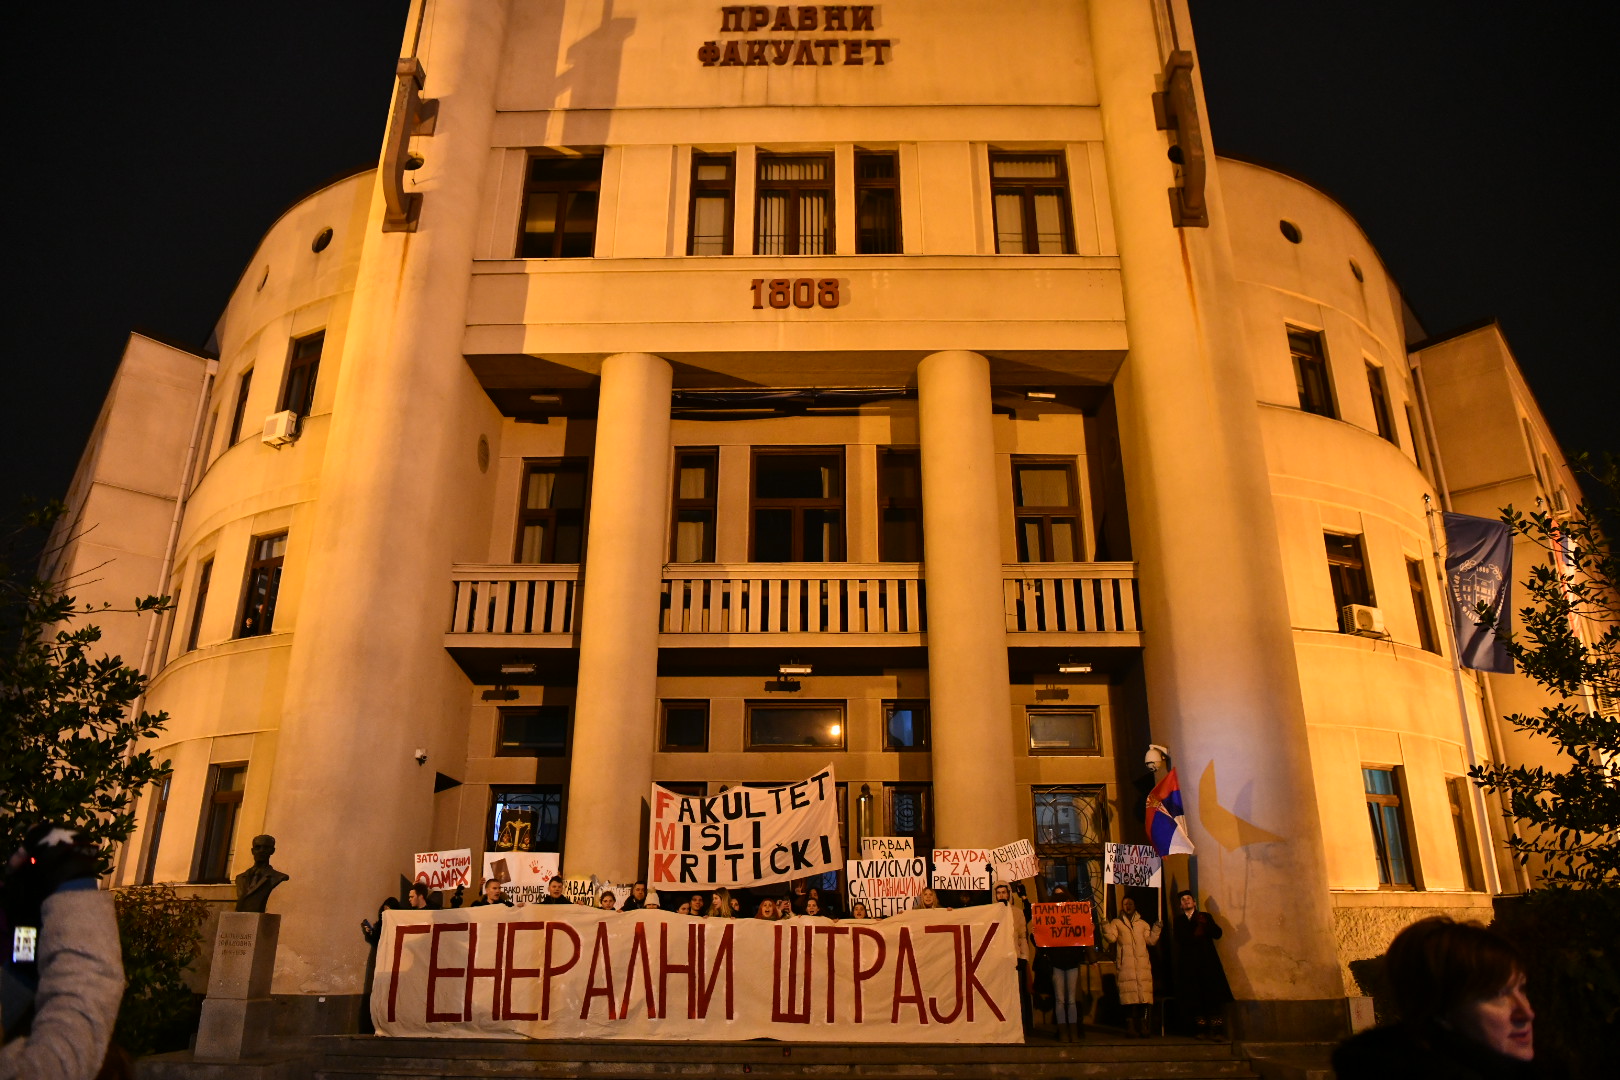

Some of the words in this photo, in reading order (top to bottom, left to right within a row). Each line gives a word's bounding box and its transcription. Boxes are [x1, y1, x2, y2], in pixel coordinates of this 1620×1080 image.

[720, 5, 874, 32] ПРАВНИ
[697, 39, 891, 67] ФАКУЛТЕТ
[750, 278, 840, 309] 1808
[655, 771, 830, 824] FAKULTET
[654, 821, 761, 852] MISLI
[862, 839, 912, 851] ПРАВДА
[989, 839, 1033, 864] АВНИЦИ
[416, 853, 439, 863] ЗАТО
[440, 856, 470, 869] УСТАНИ
[653, 835, 832, 883] KRITIČKI
[880, 850, 894, 859] ЗА
[933, 850, 988, 863] PRAVDA
[1109, 855, 1125, 863] RADA
[856, 859, 924, 878] МИСМО
[950, 863, 970, 876] ZA
[1106, 864, 1111, 872] A
[1113, 864, 1130, 873] BUNT
[1134, 865, 1153, 876] RADA
[415, 866, 470, 889] ОДМАХ
[933, 876, 986, 890] PRAVNIKE
[1113, 872, 1150, 886] SLOBODU
[522, 885, 544, 894] МАШЕ
[849, 880, 867, 897] СА
[516, 894, 534, 903] ШТО
[1034, 903, 1089, 914] ПАМТИЋЕМО
[1036, 916, 1042, 925] И
[1046, 916, 1056, 925] КО
[1061, 915, 1072, 925] ЈЕ
[387, 921, 734, 1023] ГЕНЕРАЛНИ
[771, 922, 1006, 1025] ШТРАЈК
